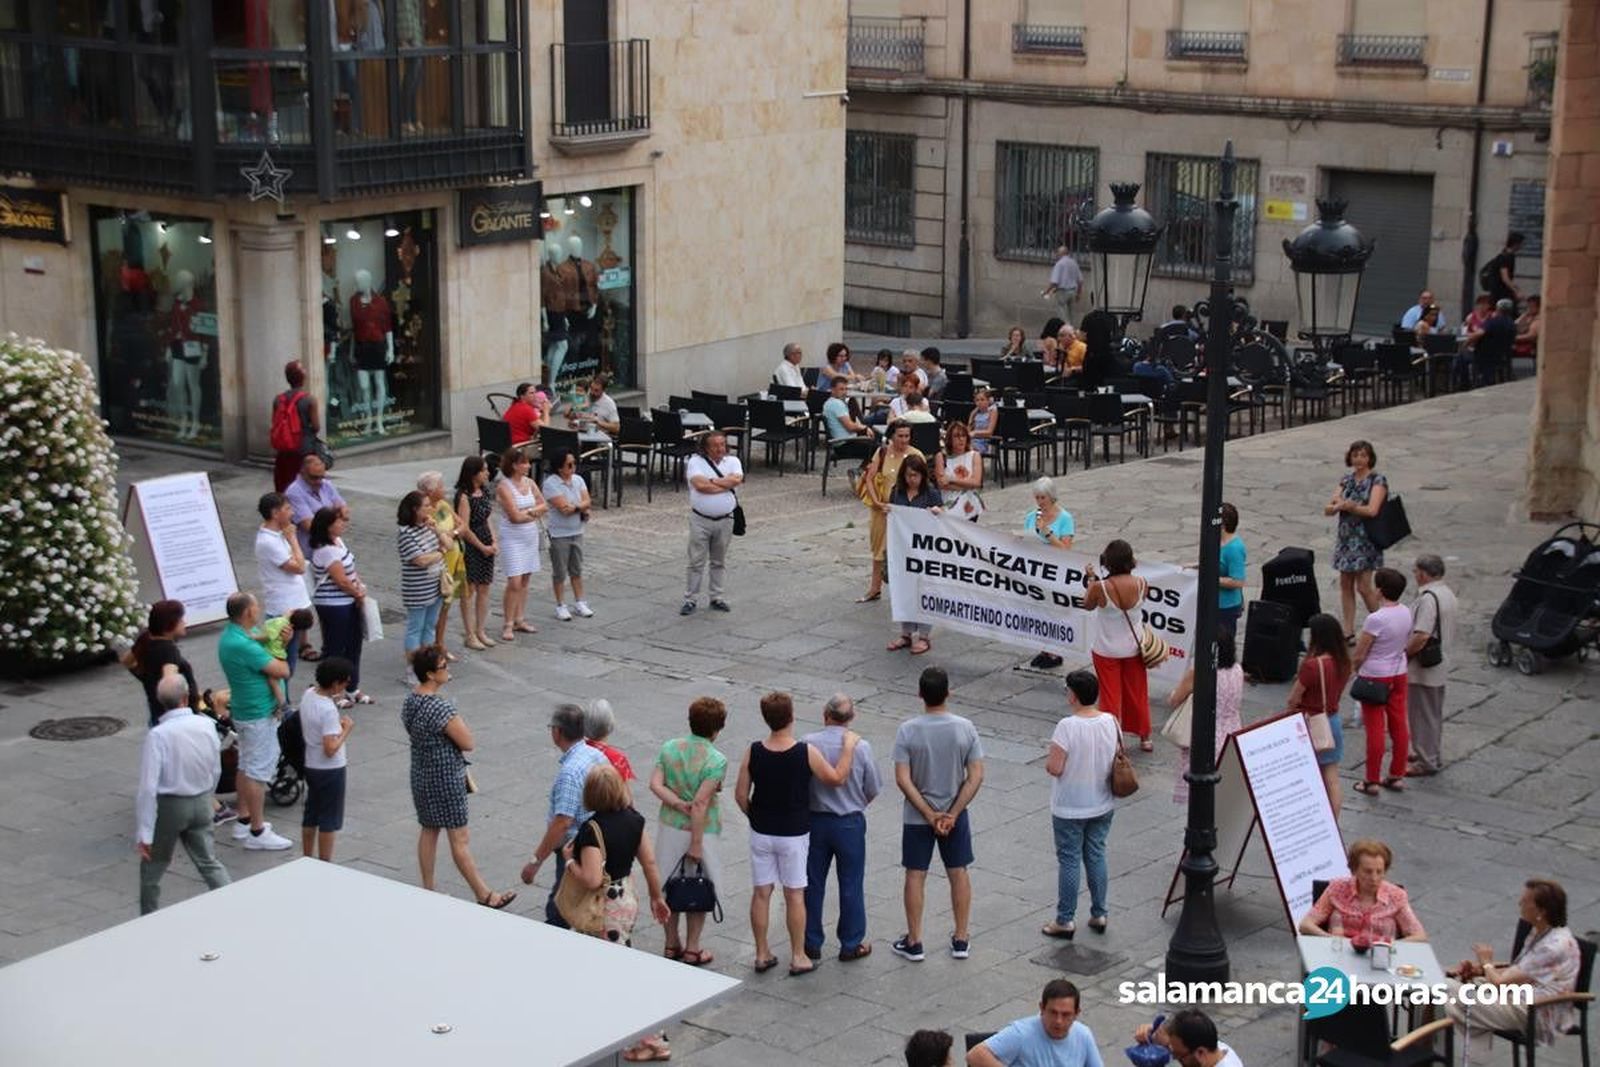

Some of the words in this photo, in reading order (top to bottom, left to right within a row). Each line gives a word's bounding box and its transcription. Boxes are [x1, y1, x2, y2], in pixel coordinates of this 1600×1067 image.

[471, 210, 532, 234] GALANTE
[905, 556, 1046, 601] DERECHOS
[912, 533, 1058, 581] MOVILÍZATE
[921, 594, 1002, 626] COMPARTIENDO
[1005, 612, 1074, 643] COMPROMISO
